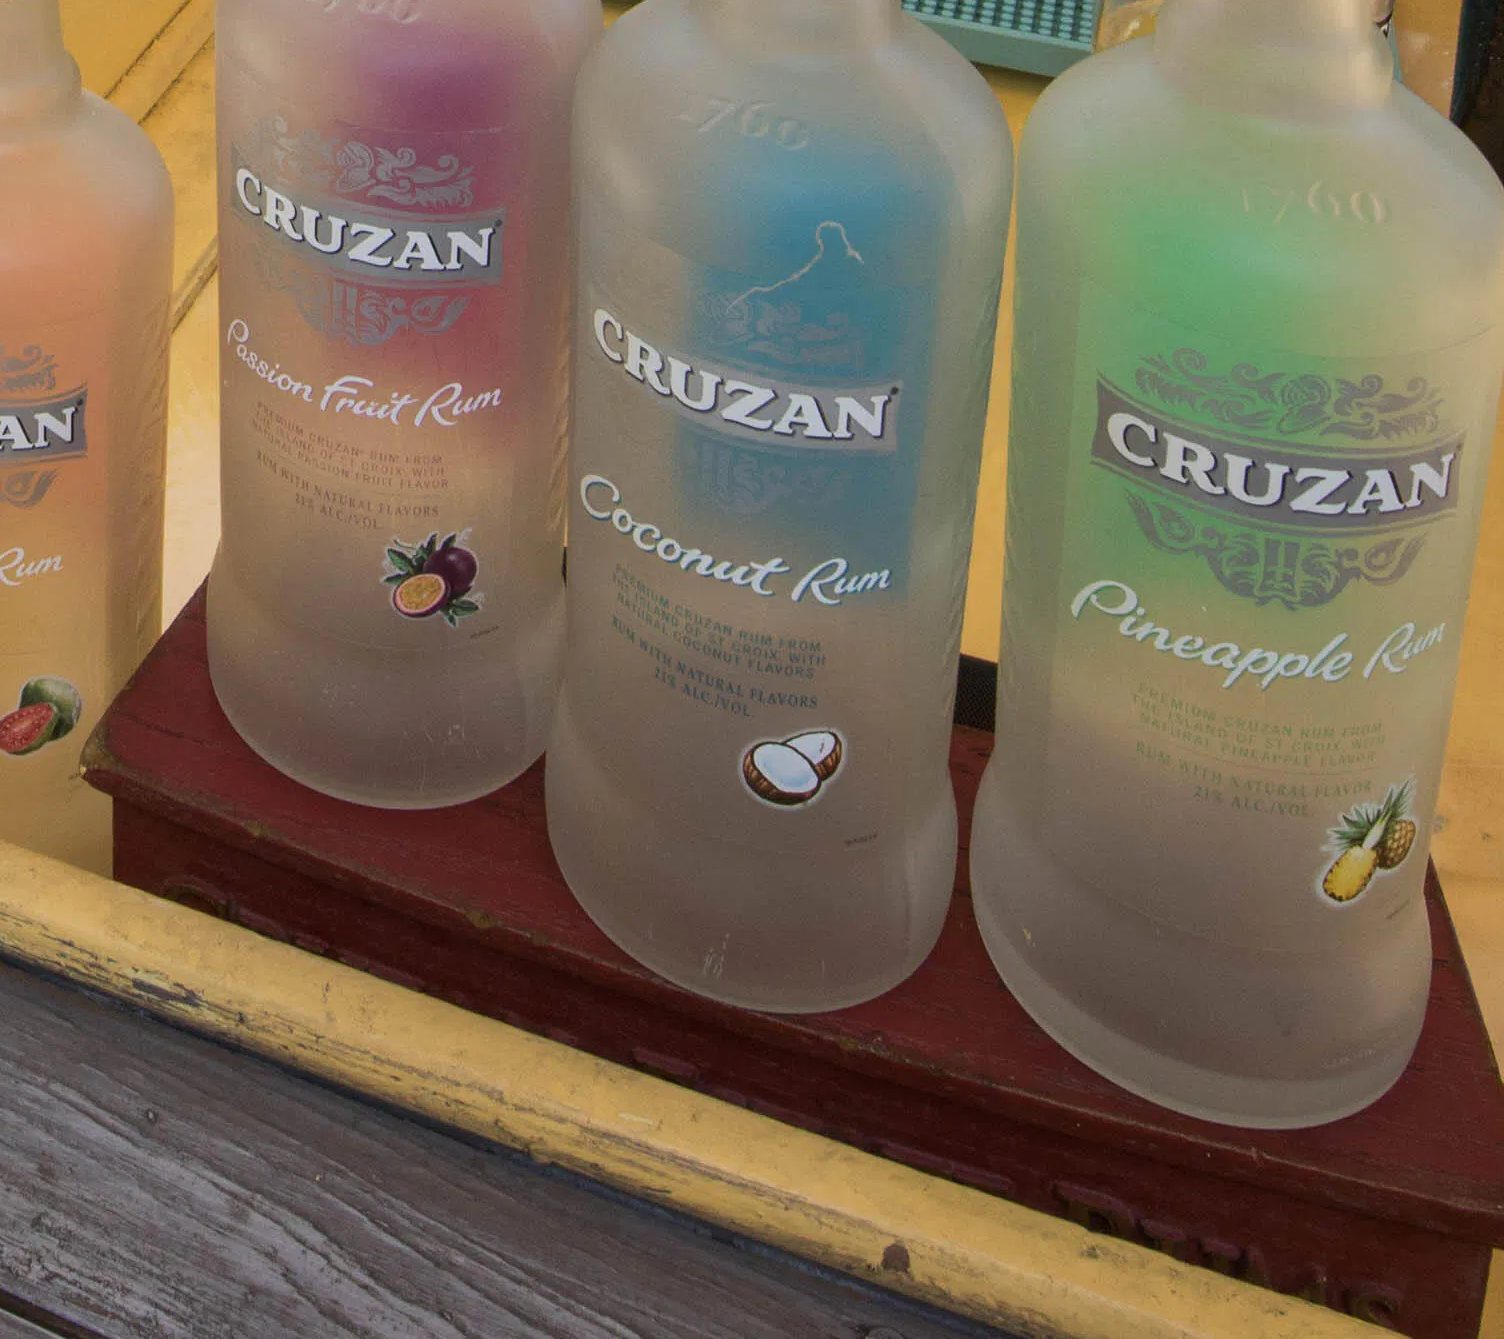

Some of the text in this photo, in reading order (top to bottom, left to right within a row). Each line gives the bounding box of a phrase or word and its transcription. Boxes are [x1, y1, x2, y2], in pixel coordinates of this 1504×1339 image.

[235, 166, 498, 272] CRUZAN
[226, 317, 503, 428] Passion Fruit Rum
[592, 307, 891, 442] CRUZAN
[1105, 410, 1455, 517] CRUZAN
[579, 473, 892, 606] Coconut Rum
[638, 636, 673, 668] WITH
[676, 659, 745, 698] NATURAL
[748, 687, 819, 710] FLAVORS
[739, 629, 774, 646] RUM
[1070, 578, 1448, 692] Pineapple Rum
